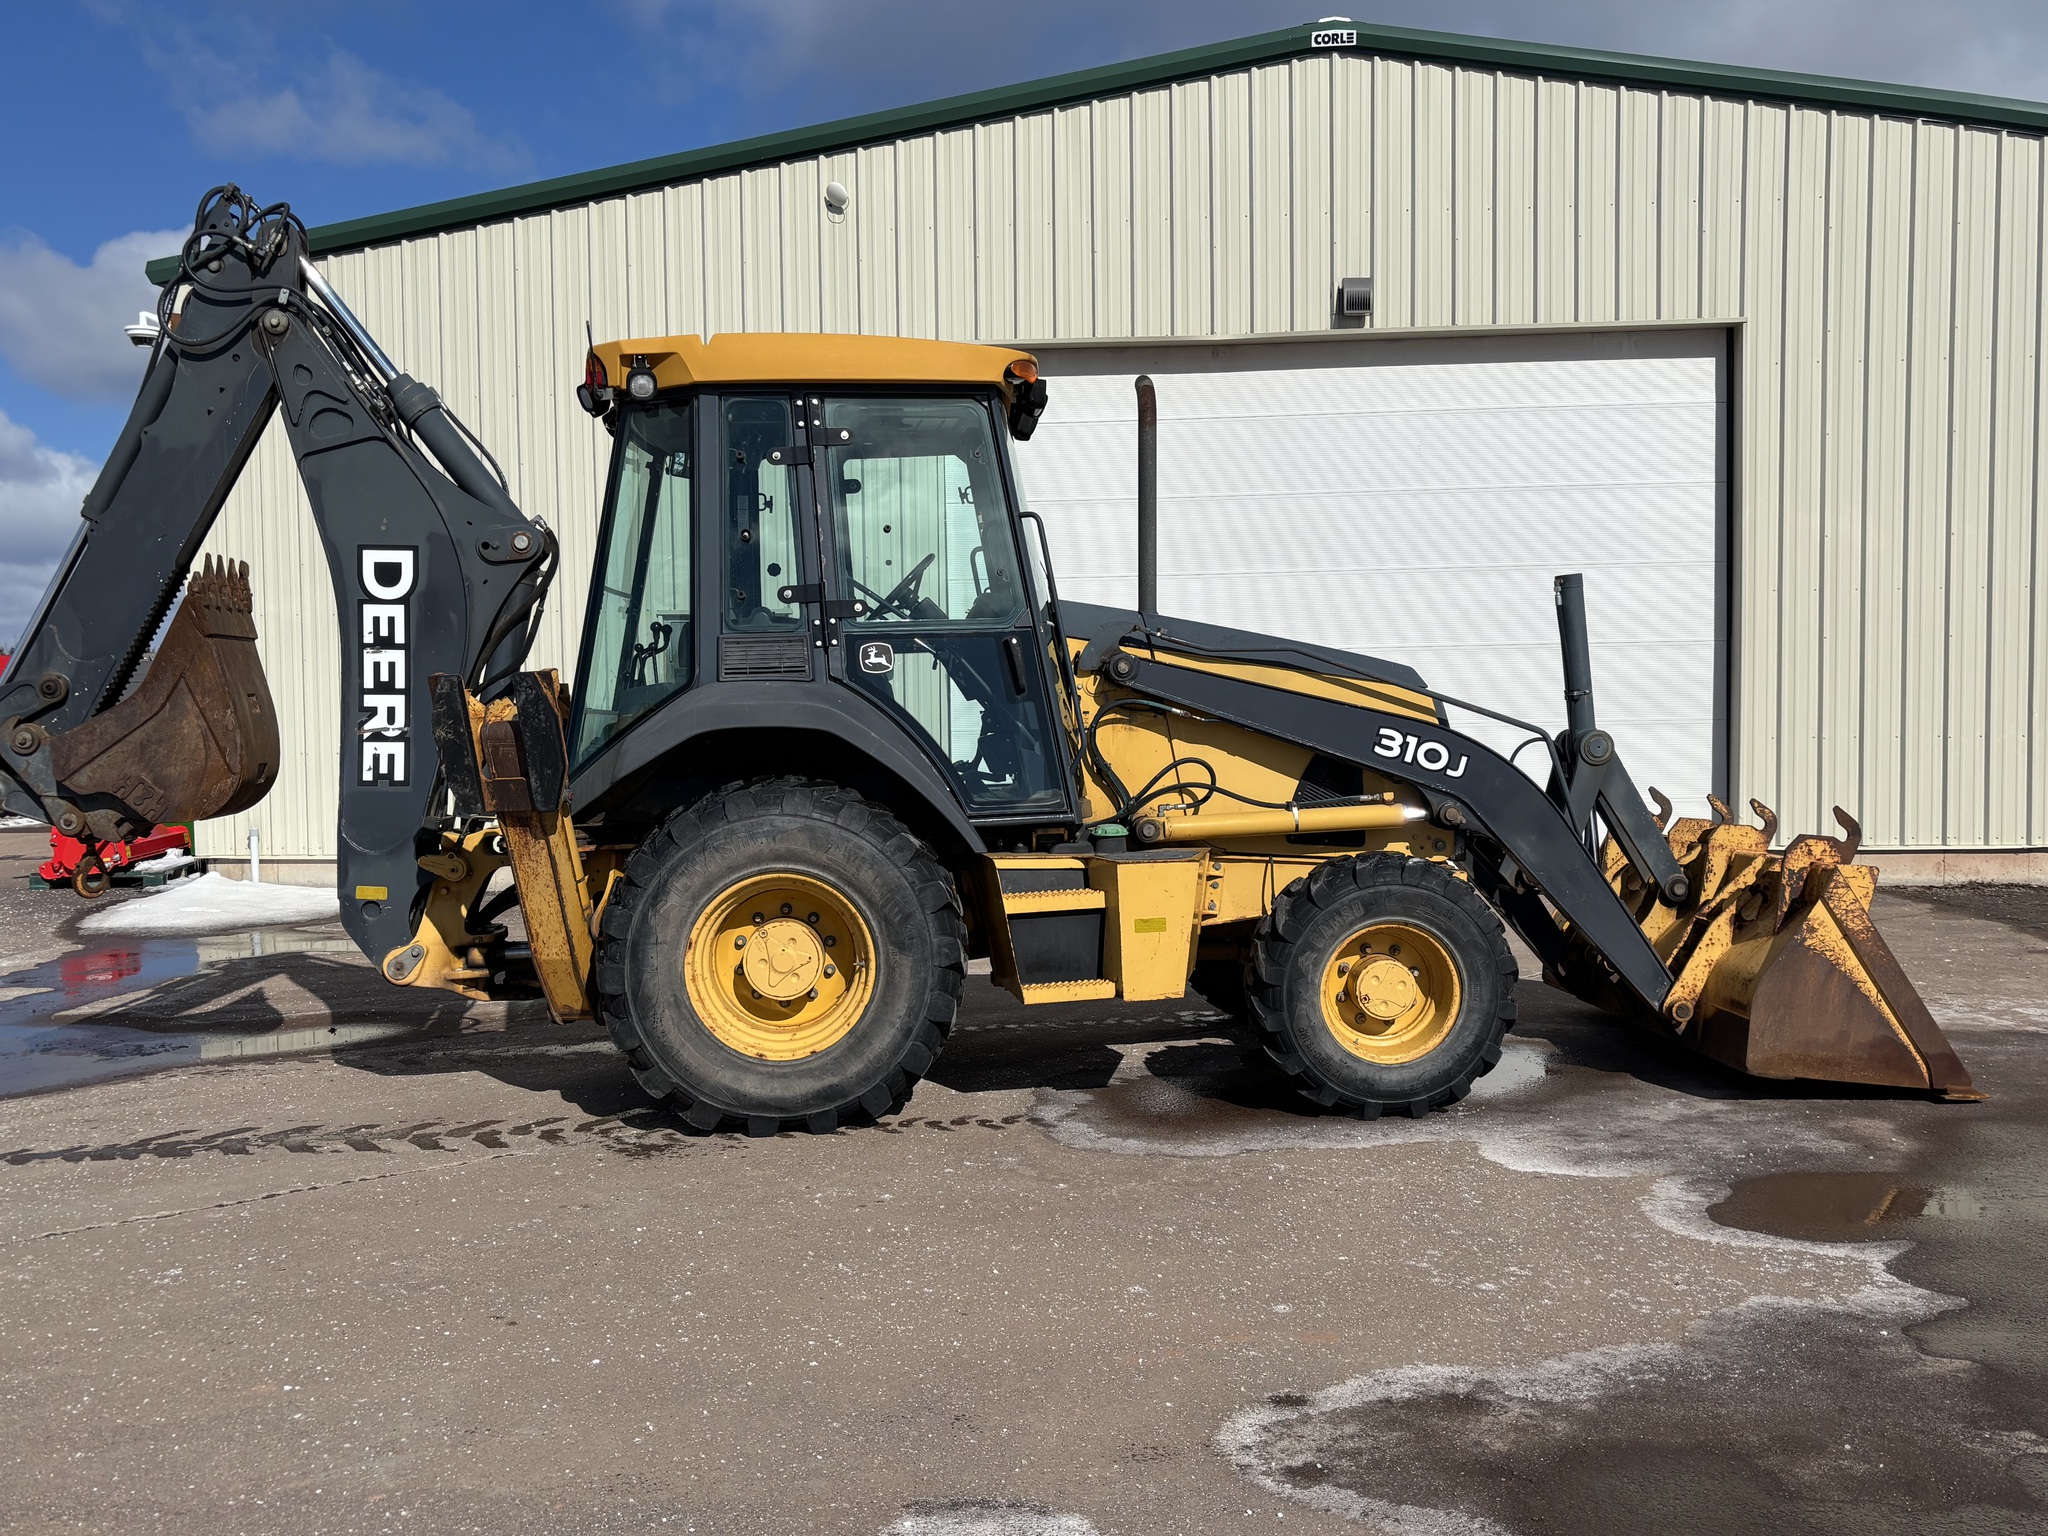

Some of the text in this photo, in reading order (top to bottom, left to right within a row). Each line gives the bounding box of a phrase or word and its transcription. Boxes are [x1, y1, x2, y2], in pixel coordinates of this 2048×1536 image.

[1313, 31, 1355, 46] CORLE
[361, 549, 414, 782] DEERE
[1373, 727, 1468, 778] 310J
[1311, 898, 1364, 948] CAMSO
